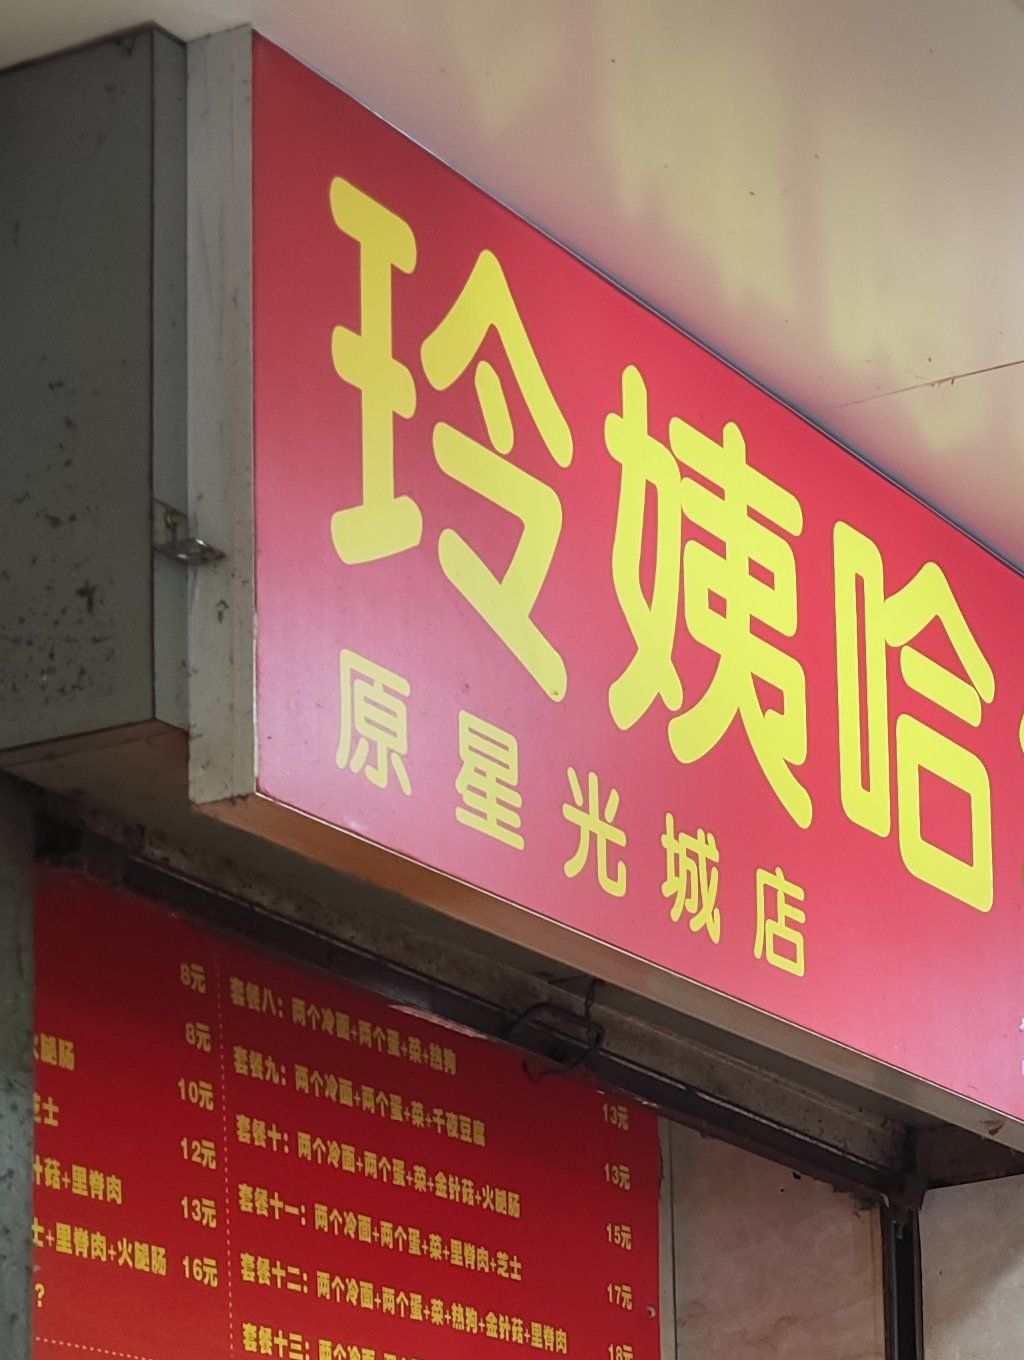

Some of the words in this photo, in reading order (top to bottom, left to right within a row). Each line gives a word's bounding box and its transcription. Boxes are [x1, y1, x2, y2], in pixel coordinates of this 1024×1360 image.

[333, 648, 807, 978] 原星光城店
[180, 963, 206, 994] 8元
[185, 1022, 212, 1053] 8元
[178, 1077, 214, 1111] 10元
[603, 1102, 629, 1131] 13元
[180, 1137, 217, 1170] 12元
[604, 1163, 631, 1190] 13元
[180, 1196, 217, 1228] 13元
[606, 1222, 632, 1251] 15元
[182, 1255, 218, 1288] 16元
[607, 1283, 633, 1311] 17元
